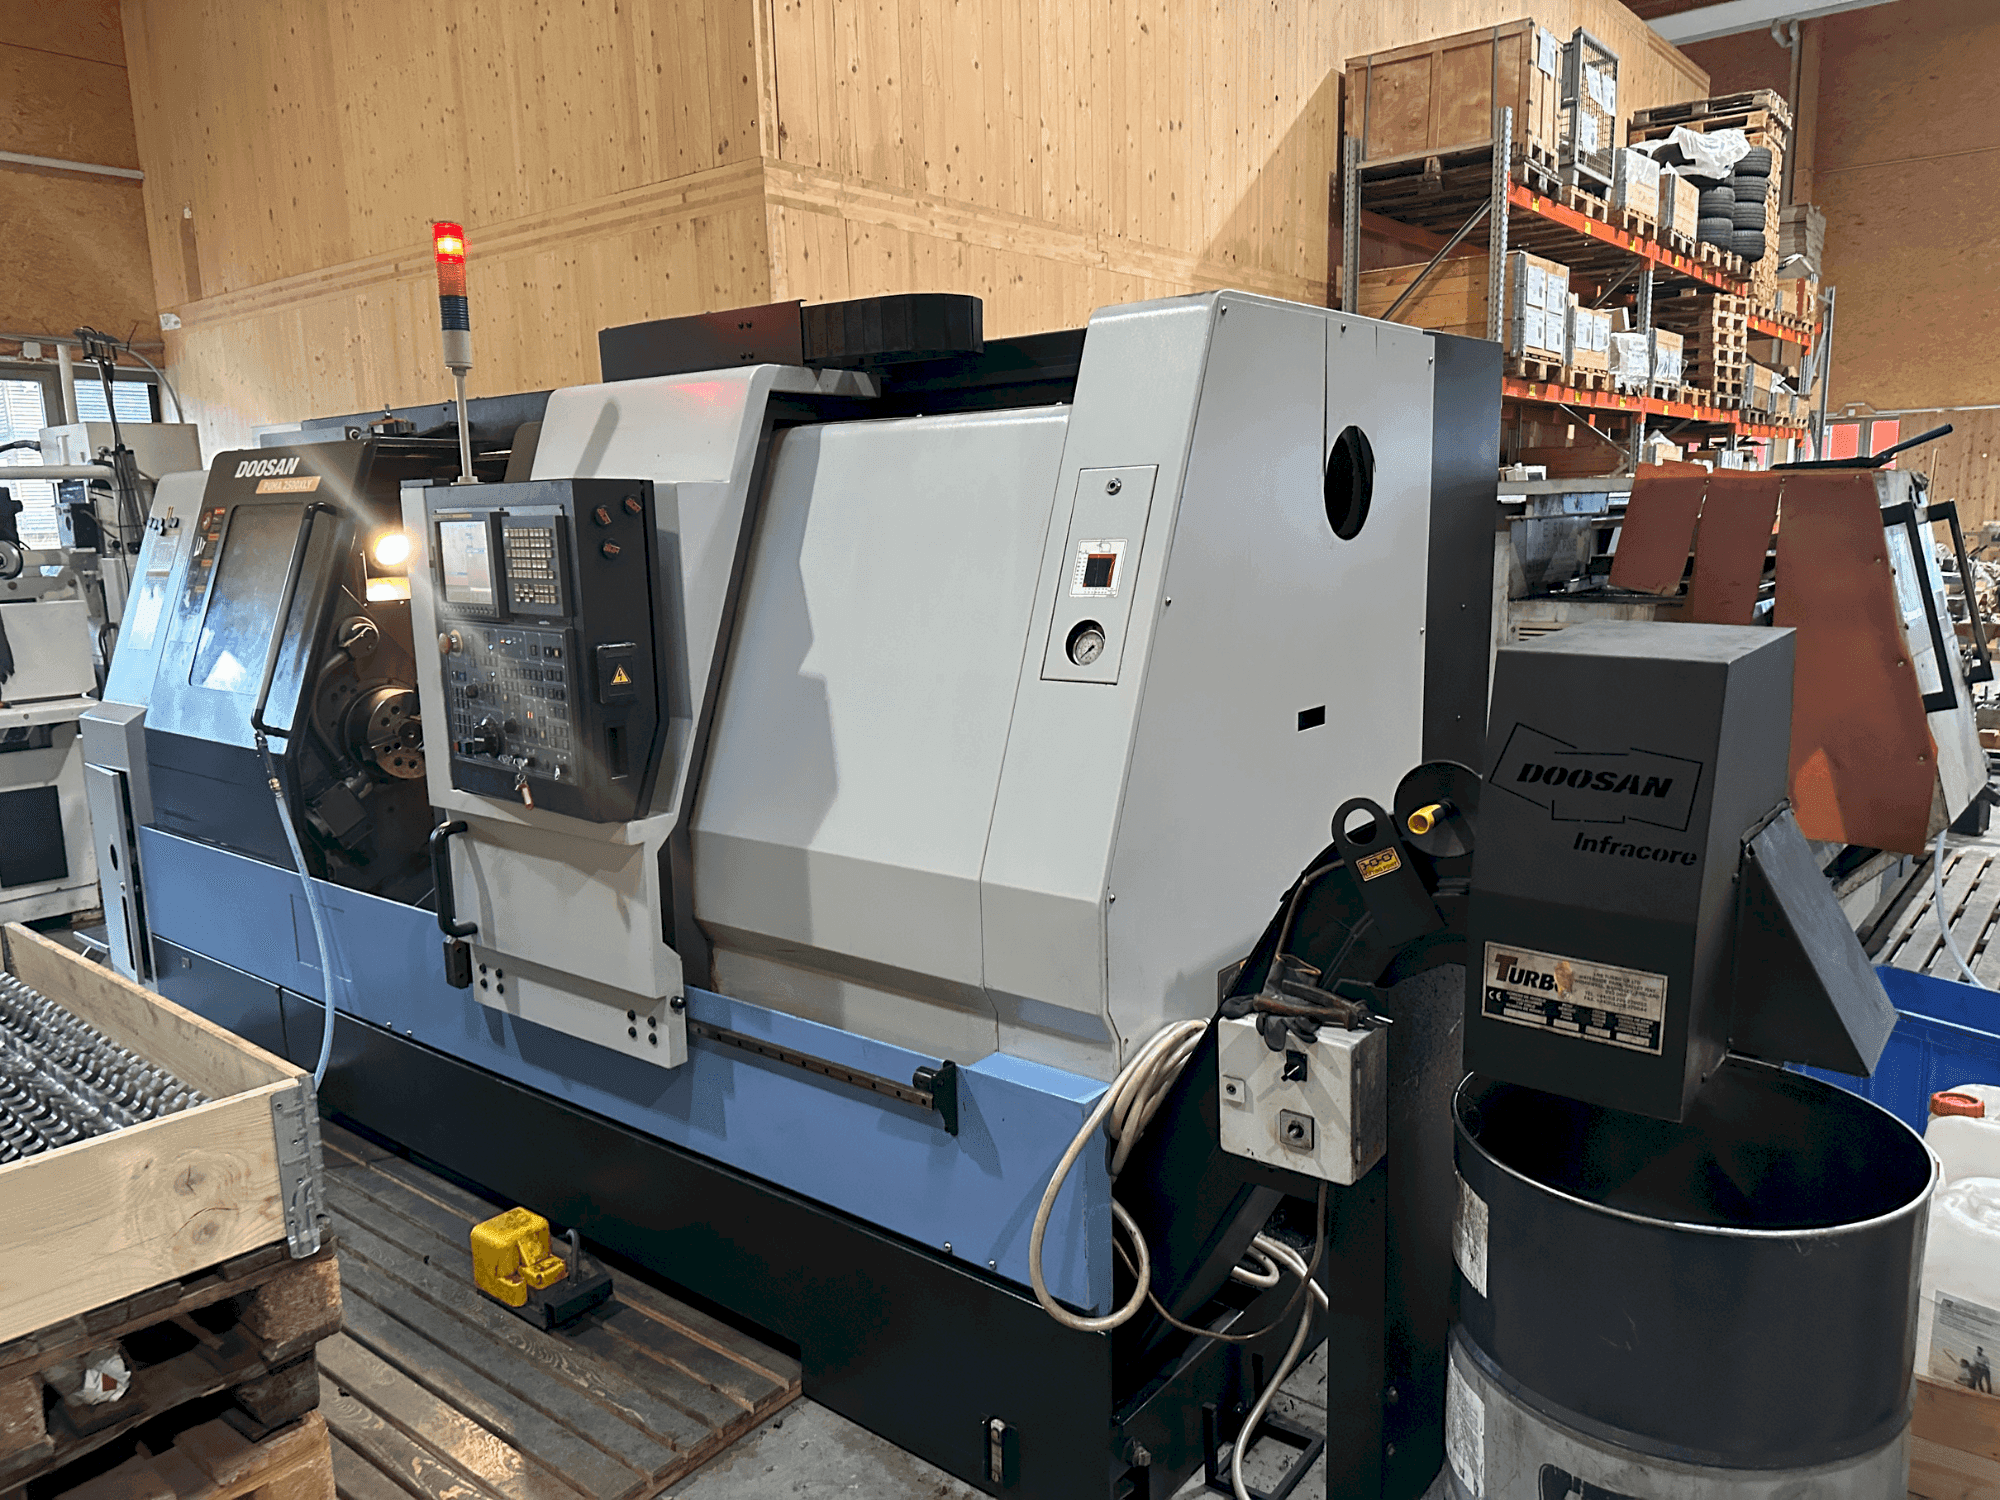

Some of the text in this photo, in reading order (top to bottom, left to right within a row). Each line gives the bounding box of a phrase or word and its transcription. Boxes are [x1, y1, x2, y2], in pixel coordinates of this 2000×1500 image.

[234, 457, 300, 478] DOOSAN
[1516, 763, 1673, 798] DOOSAN
[1573, 832, 1698, 867] Infracore
[1495, 953, 1559, 992] TURB
